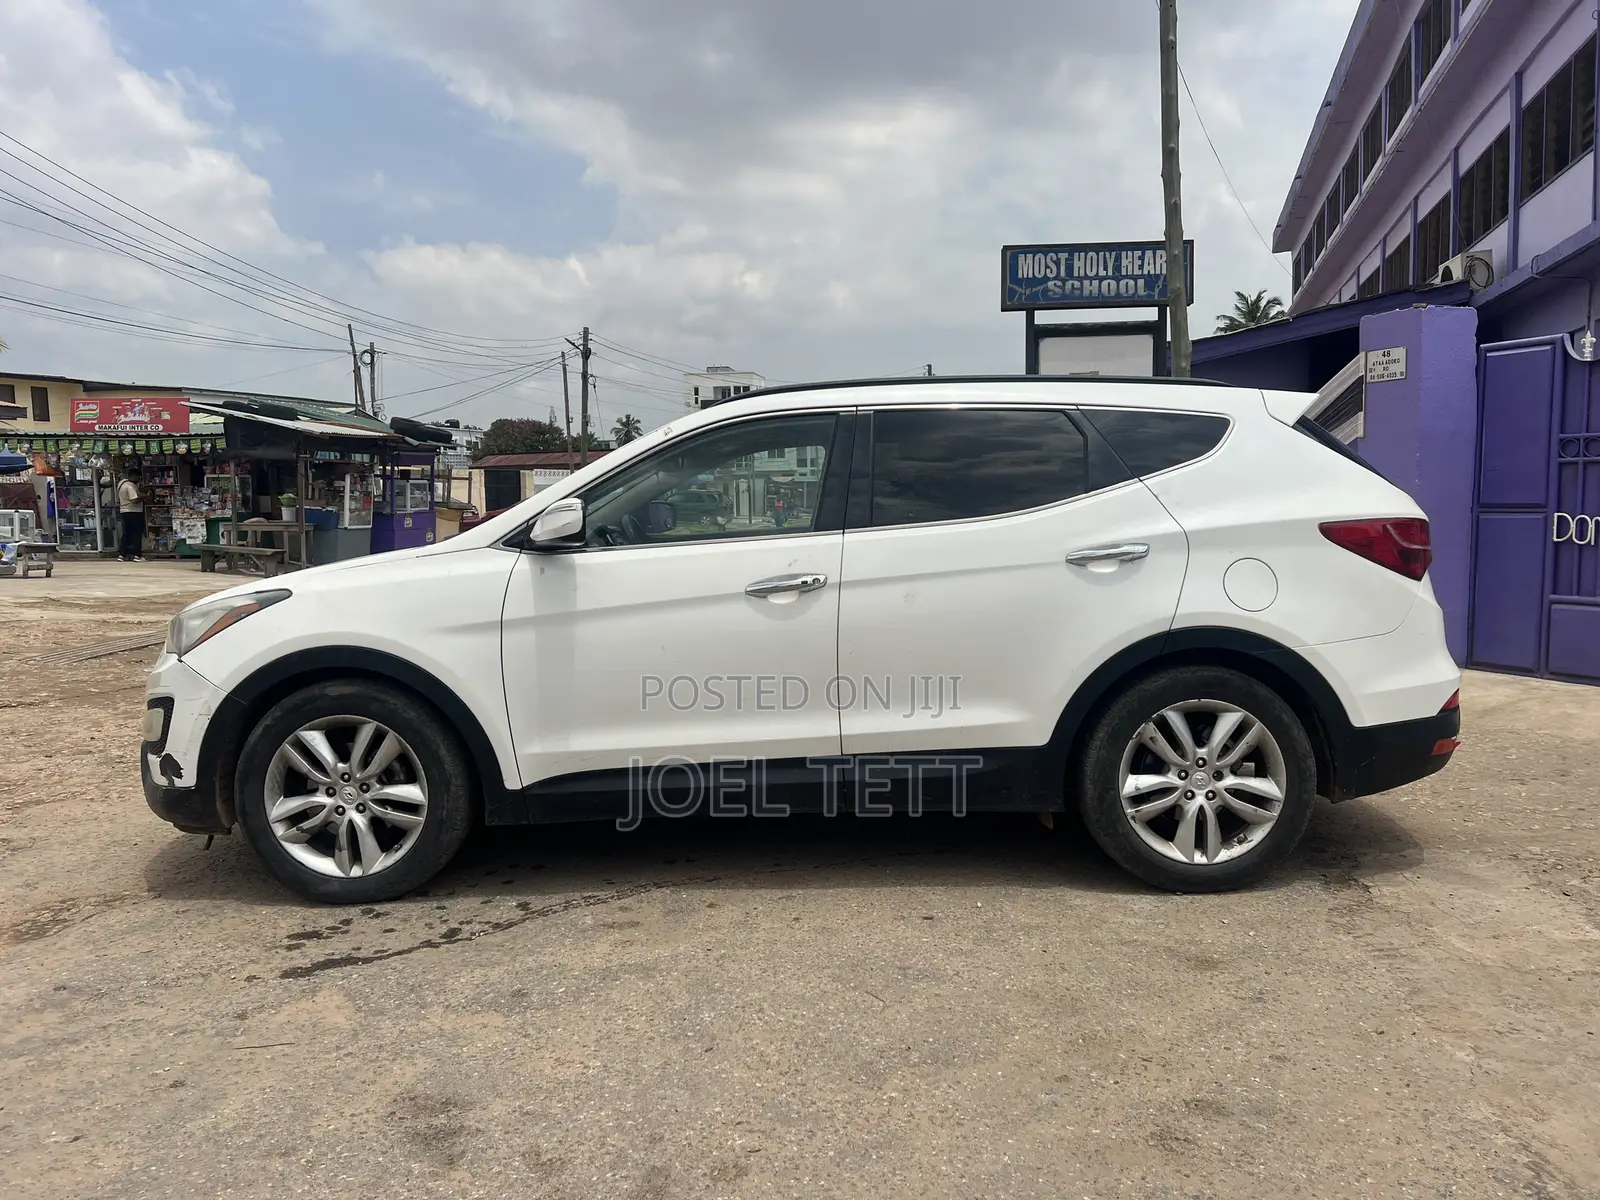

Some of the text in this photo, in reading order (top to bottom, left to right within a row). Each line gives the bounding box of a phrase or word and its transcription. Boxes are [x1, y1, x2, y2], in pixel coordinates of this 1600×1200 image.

[1018, 250, 1167, 279] MOST HOLY HEAR
[1048, 279, 1147, 297] SCHOOL
[1381, 350, 1391, 358] 48
